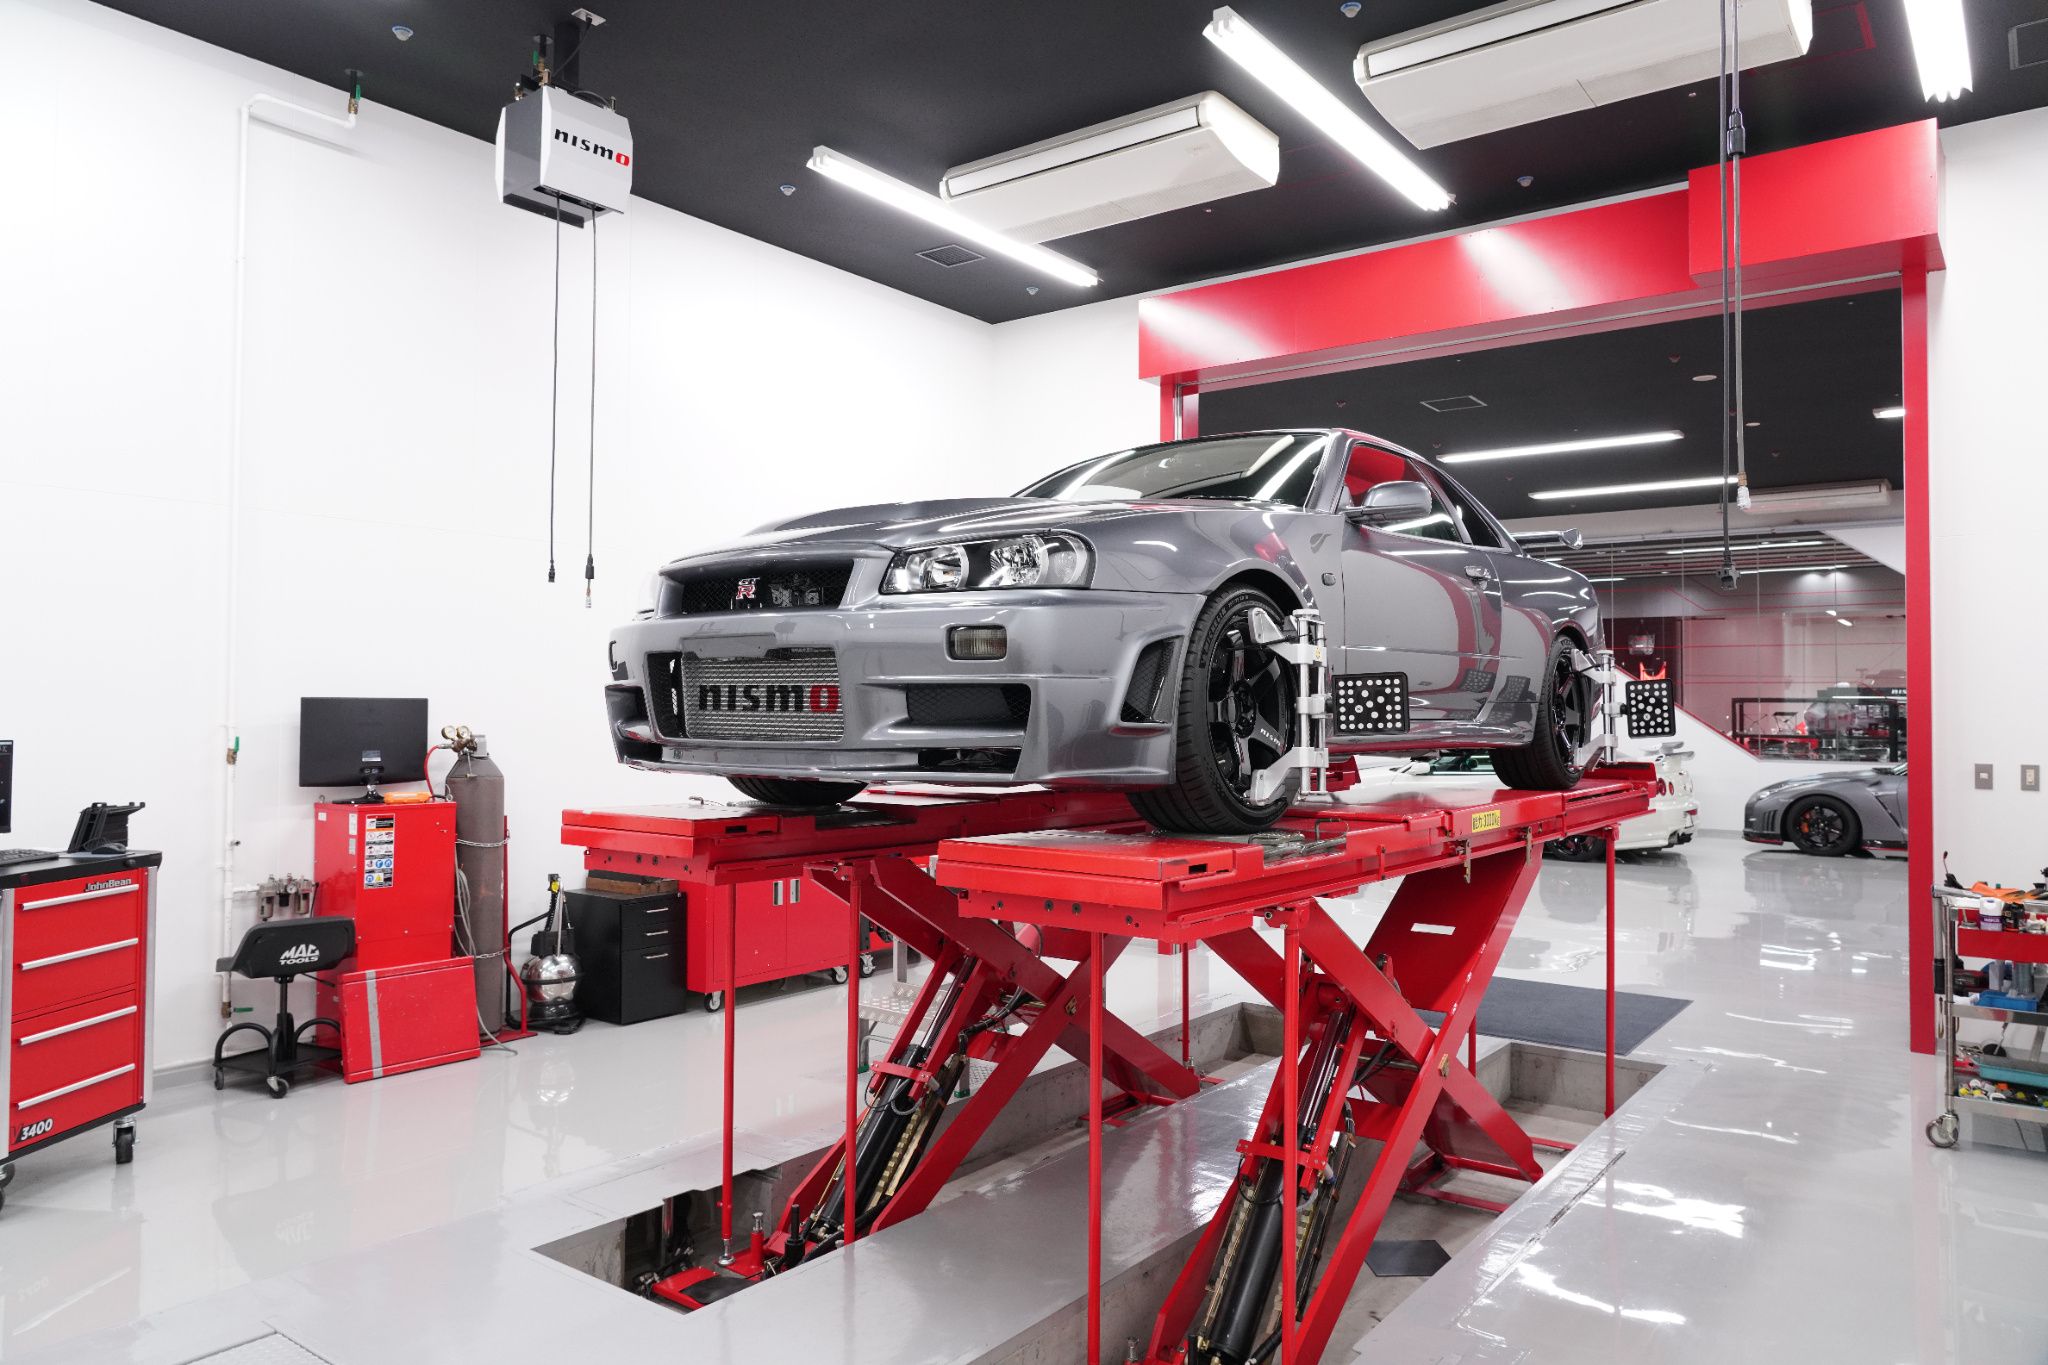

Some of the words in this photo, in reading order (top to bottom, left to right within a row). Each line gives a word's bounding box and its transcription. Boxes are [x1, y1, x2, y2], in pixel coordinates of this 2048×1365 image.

[555, 129, 630, 167] nismo
[736, 584, 755, 600] R
[699, 683, 839, 713] nismo
[280, 943, 320, 960] MAC
[280, 956, 319, 966] TOOLS
